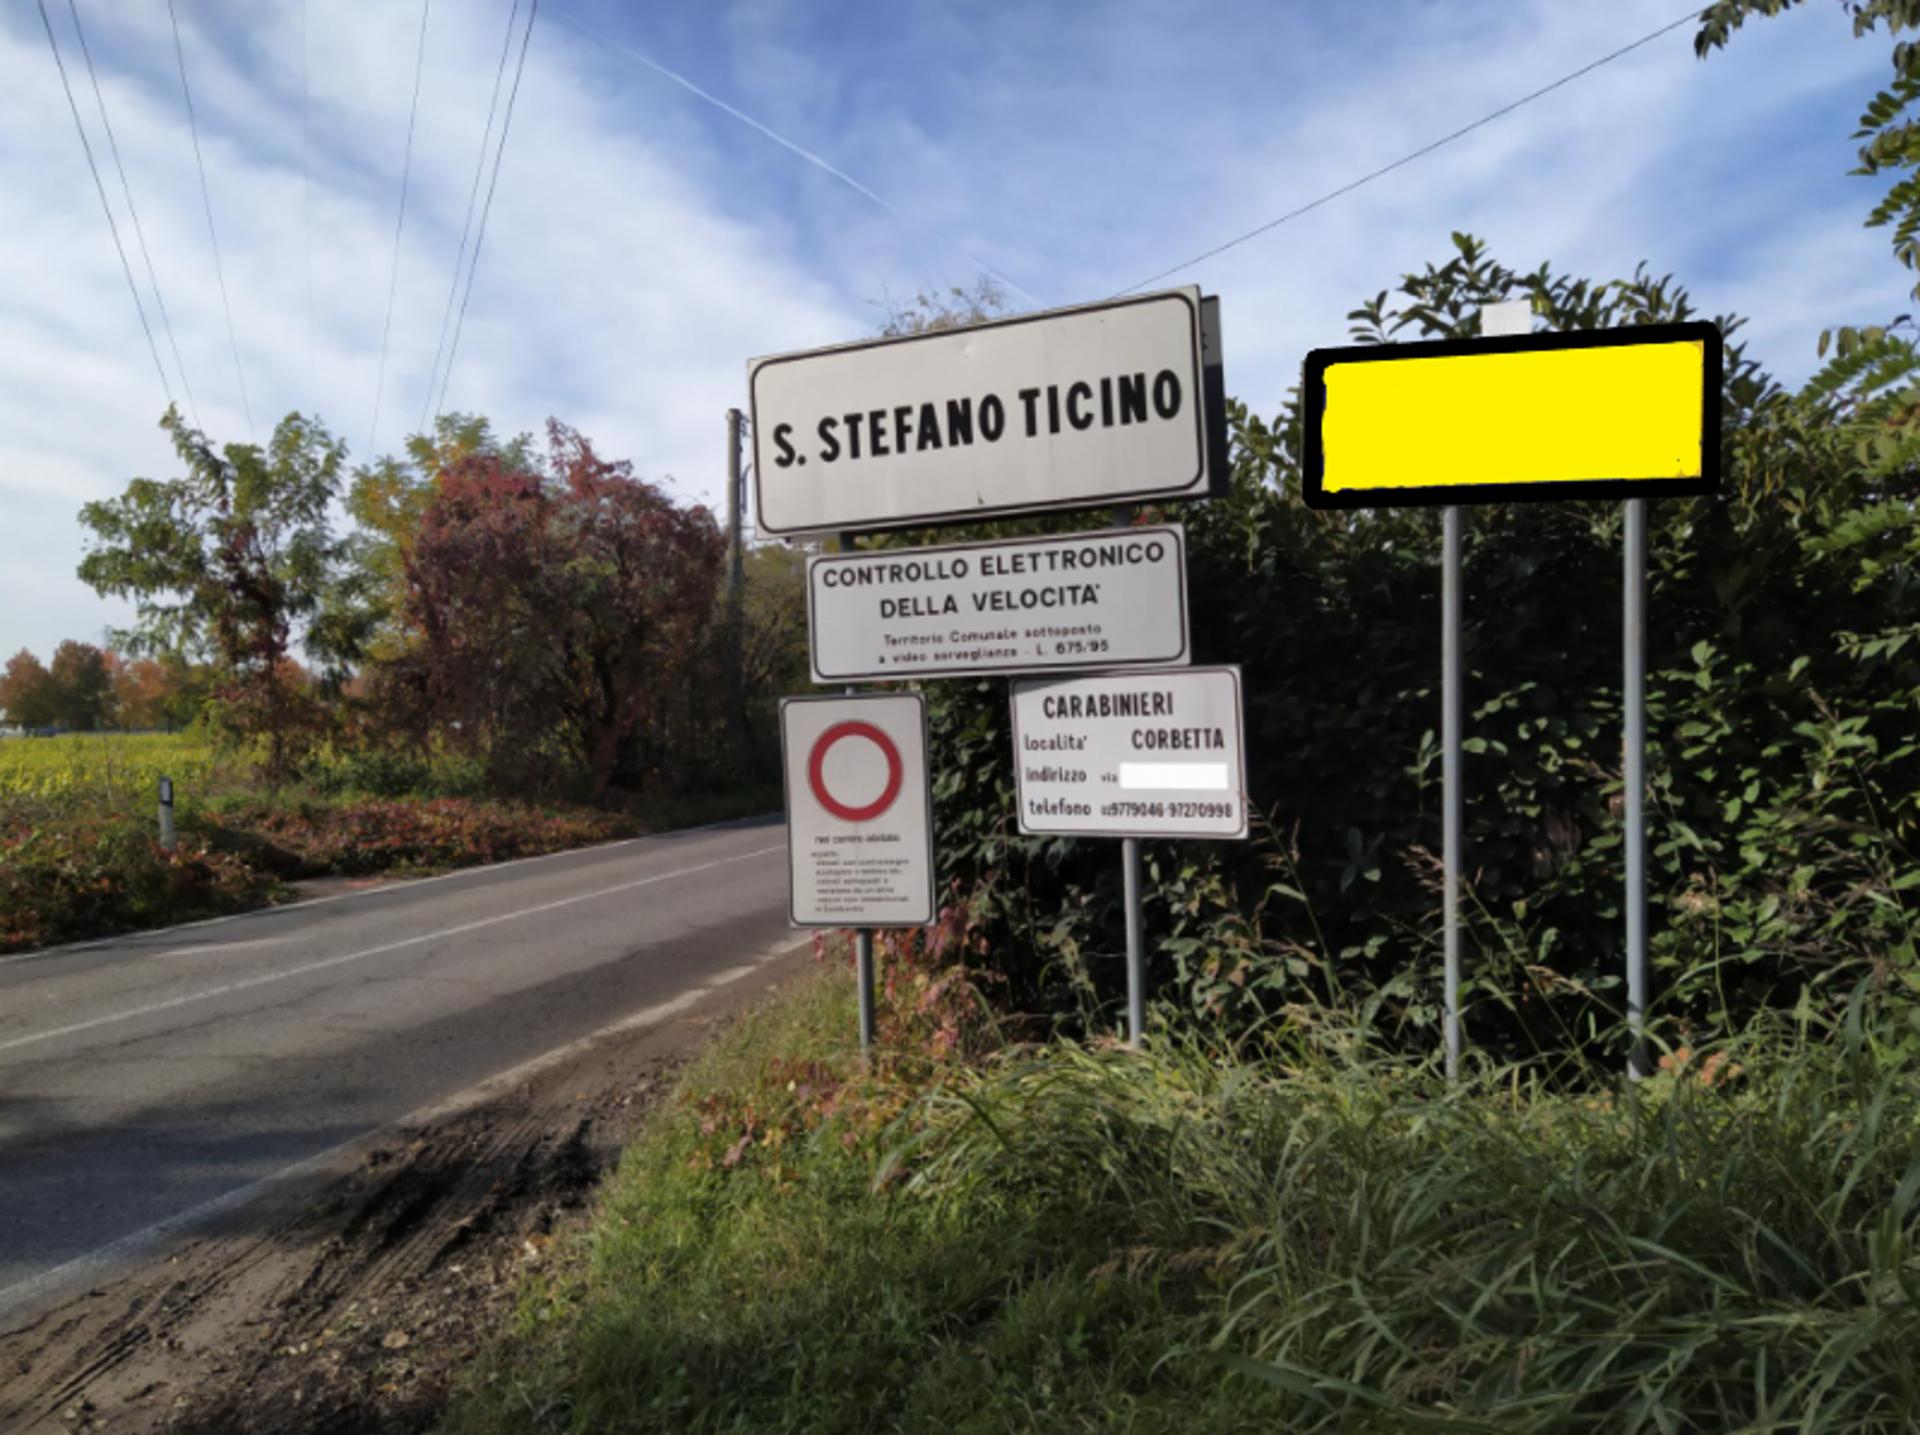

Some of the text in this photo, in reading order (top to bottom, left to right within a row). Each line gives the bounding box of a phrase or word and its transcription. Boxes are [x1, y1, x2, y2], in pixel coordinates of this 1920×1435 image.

[772, 369, 1182, 468] S. STEFANO TICINO
[823, 541, 1165, 588] CONTROLLO ELETTRONICO
[880, 594, 959, 619] DELLA
[949, 628, 1018, 643] Comunale
[1025, 624, 1102, 639] sottoposto
[1042, 691, 1174, 719] CARABINIERI
[1131, 727, 1225, 750] CORBETTA
[1025, 766, 1087, 783] indirizzo
[1029, 798, 1092, 817] telefono
